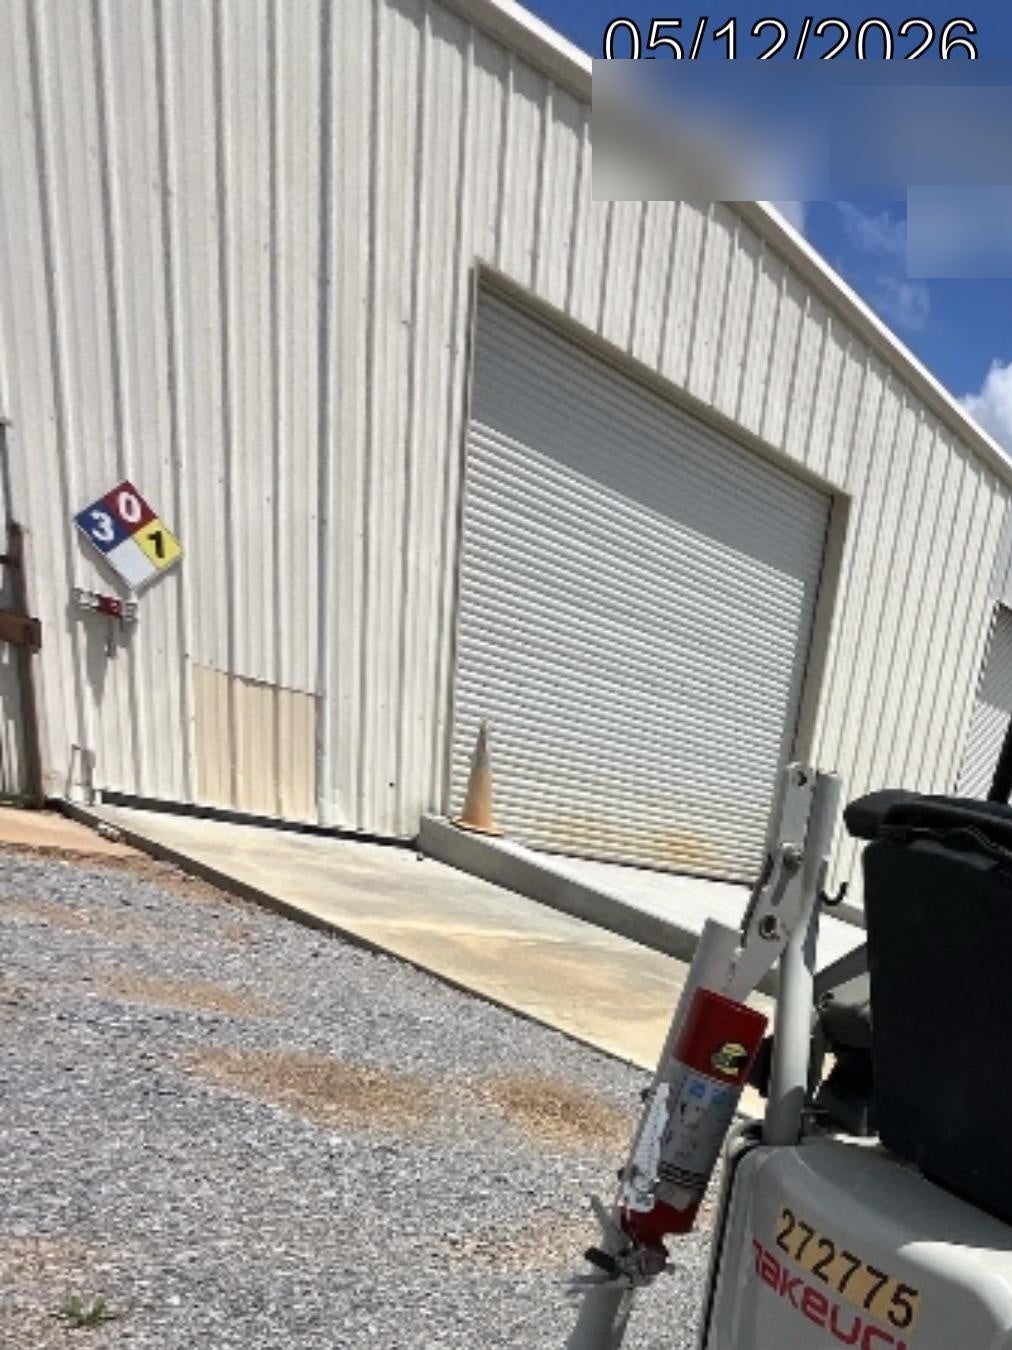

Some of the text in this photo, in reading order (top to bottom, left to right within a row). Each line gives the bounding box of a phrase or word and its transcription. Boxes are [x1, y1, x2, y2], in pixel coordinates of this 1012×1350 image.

[118, 491, 141, 523] 0
[90, 509, 114, 542] 3
[776, 1208, 919, 1329] 272775
